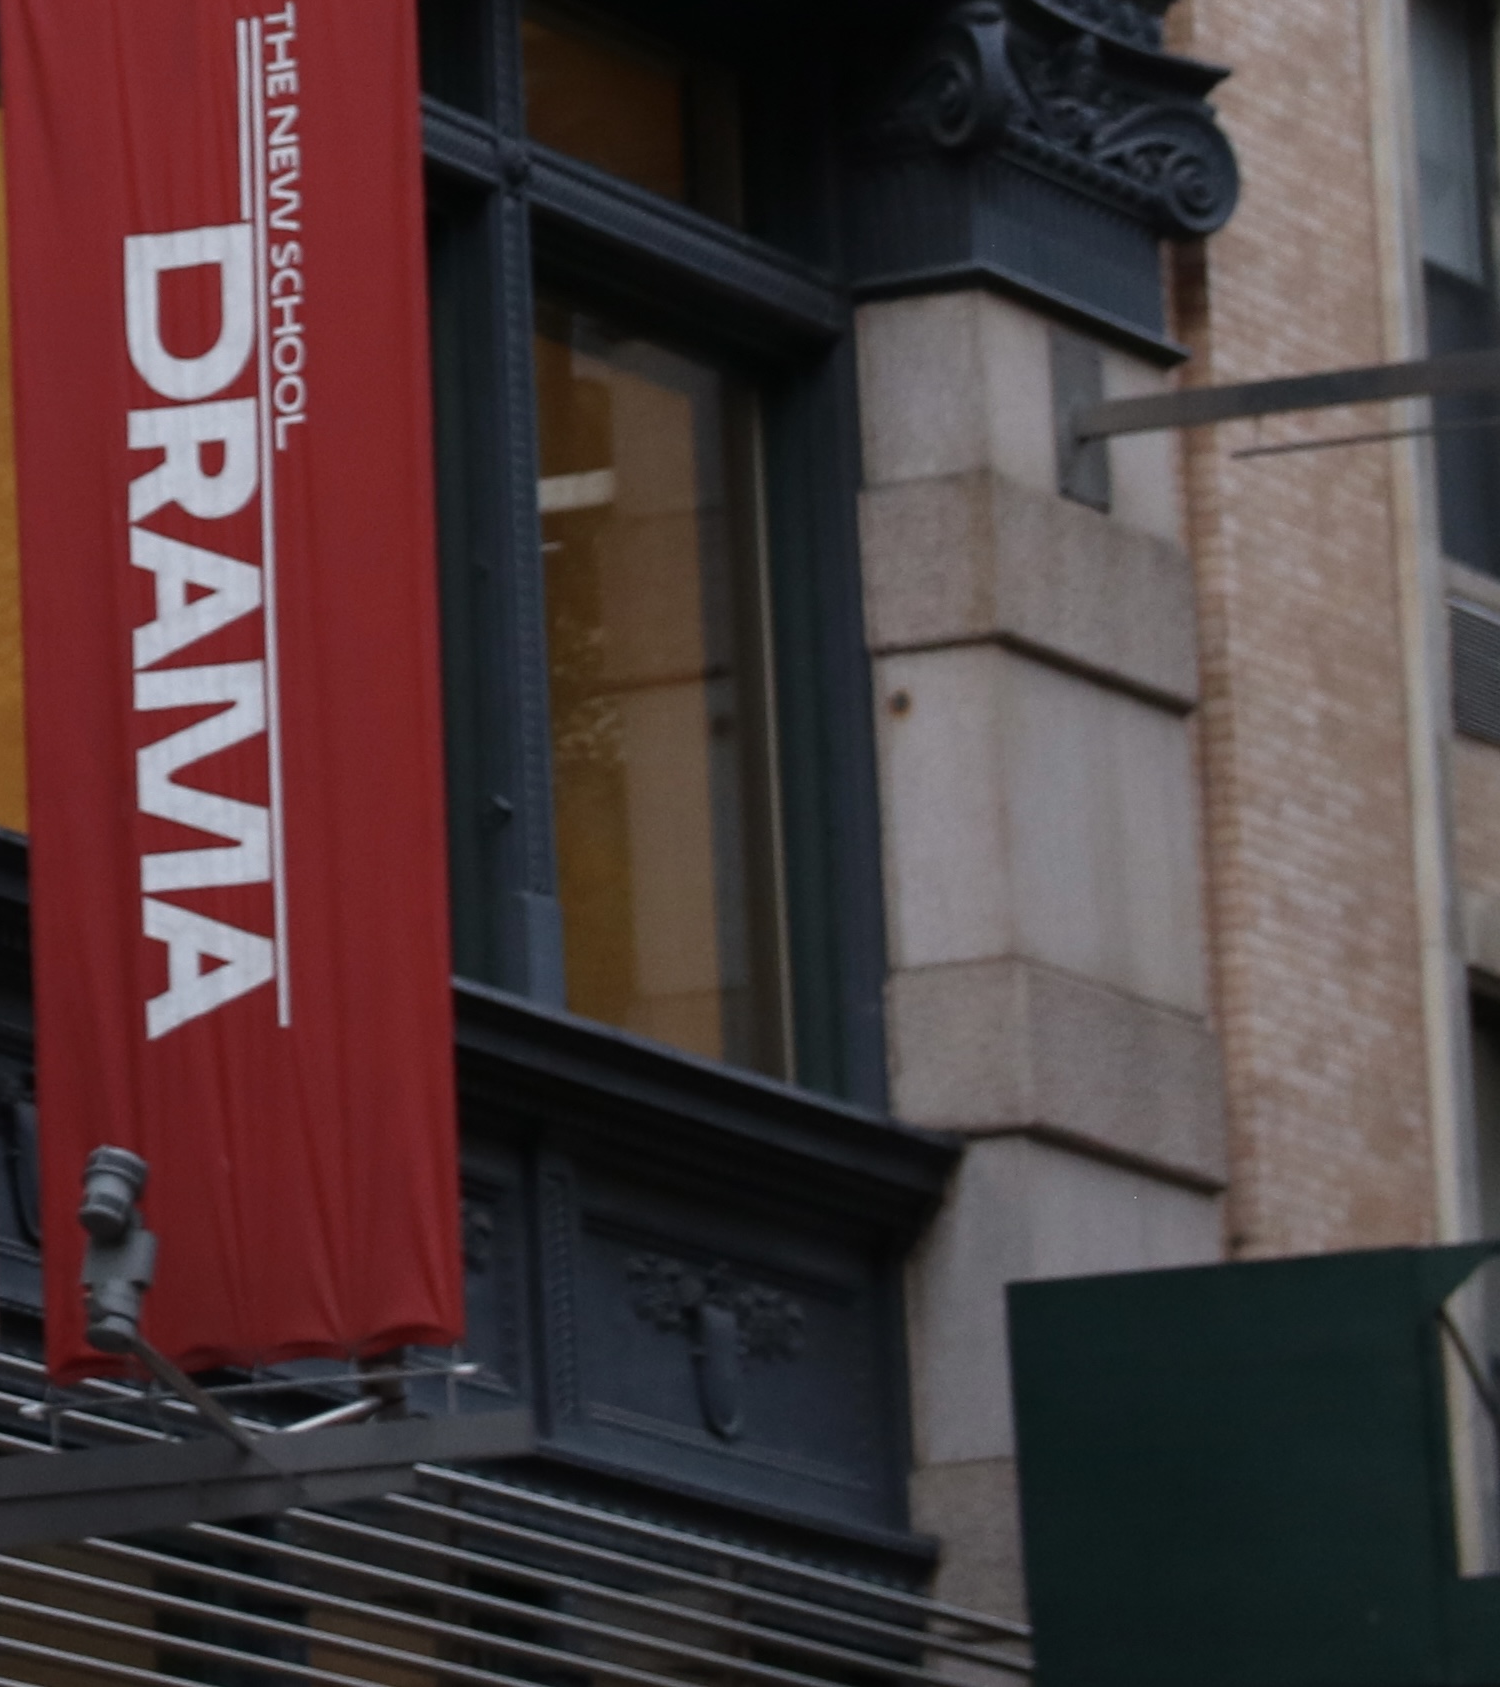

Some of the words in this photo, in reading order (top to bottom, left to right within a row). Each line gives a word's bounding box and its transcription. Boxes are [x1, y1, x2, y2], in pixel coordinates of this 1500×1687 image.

[264, 1, 299, 99] THE
[267, 106, 301, 232] NEW
[271, 241, 307, 451] SCHOOL
[124, 221, 277, 1043] DRAMA
